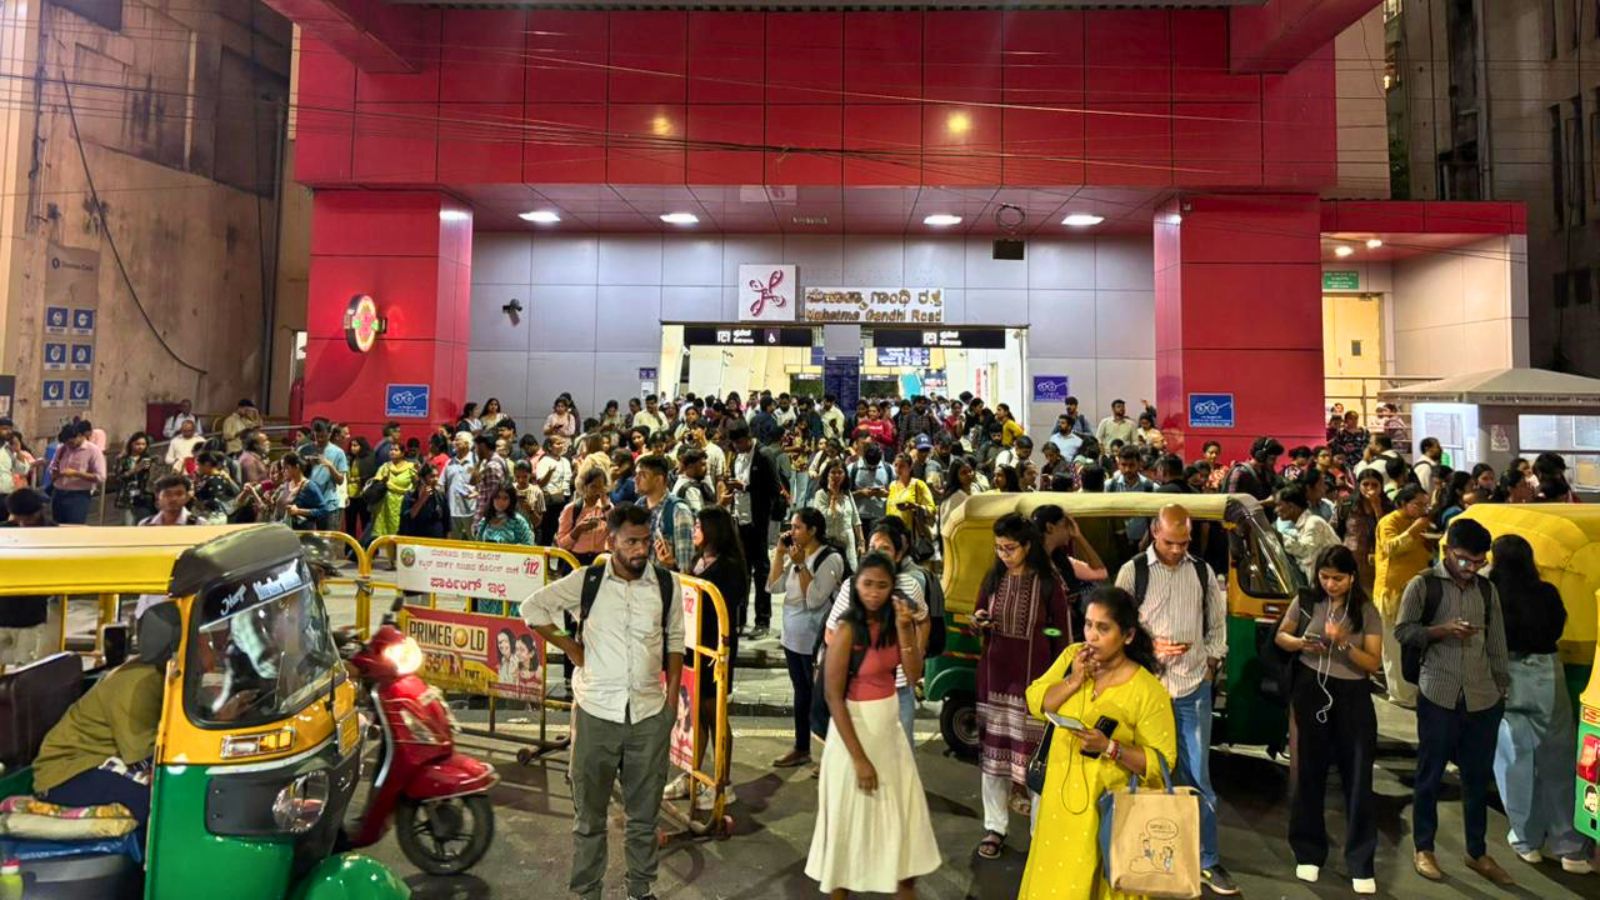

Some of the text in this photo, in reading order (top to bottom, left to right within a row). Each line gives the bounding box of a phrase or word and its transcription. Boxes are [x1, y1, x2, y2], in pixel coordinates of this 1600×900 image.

[806, 308, 942, 321] Mahatma Gandhi Road
